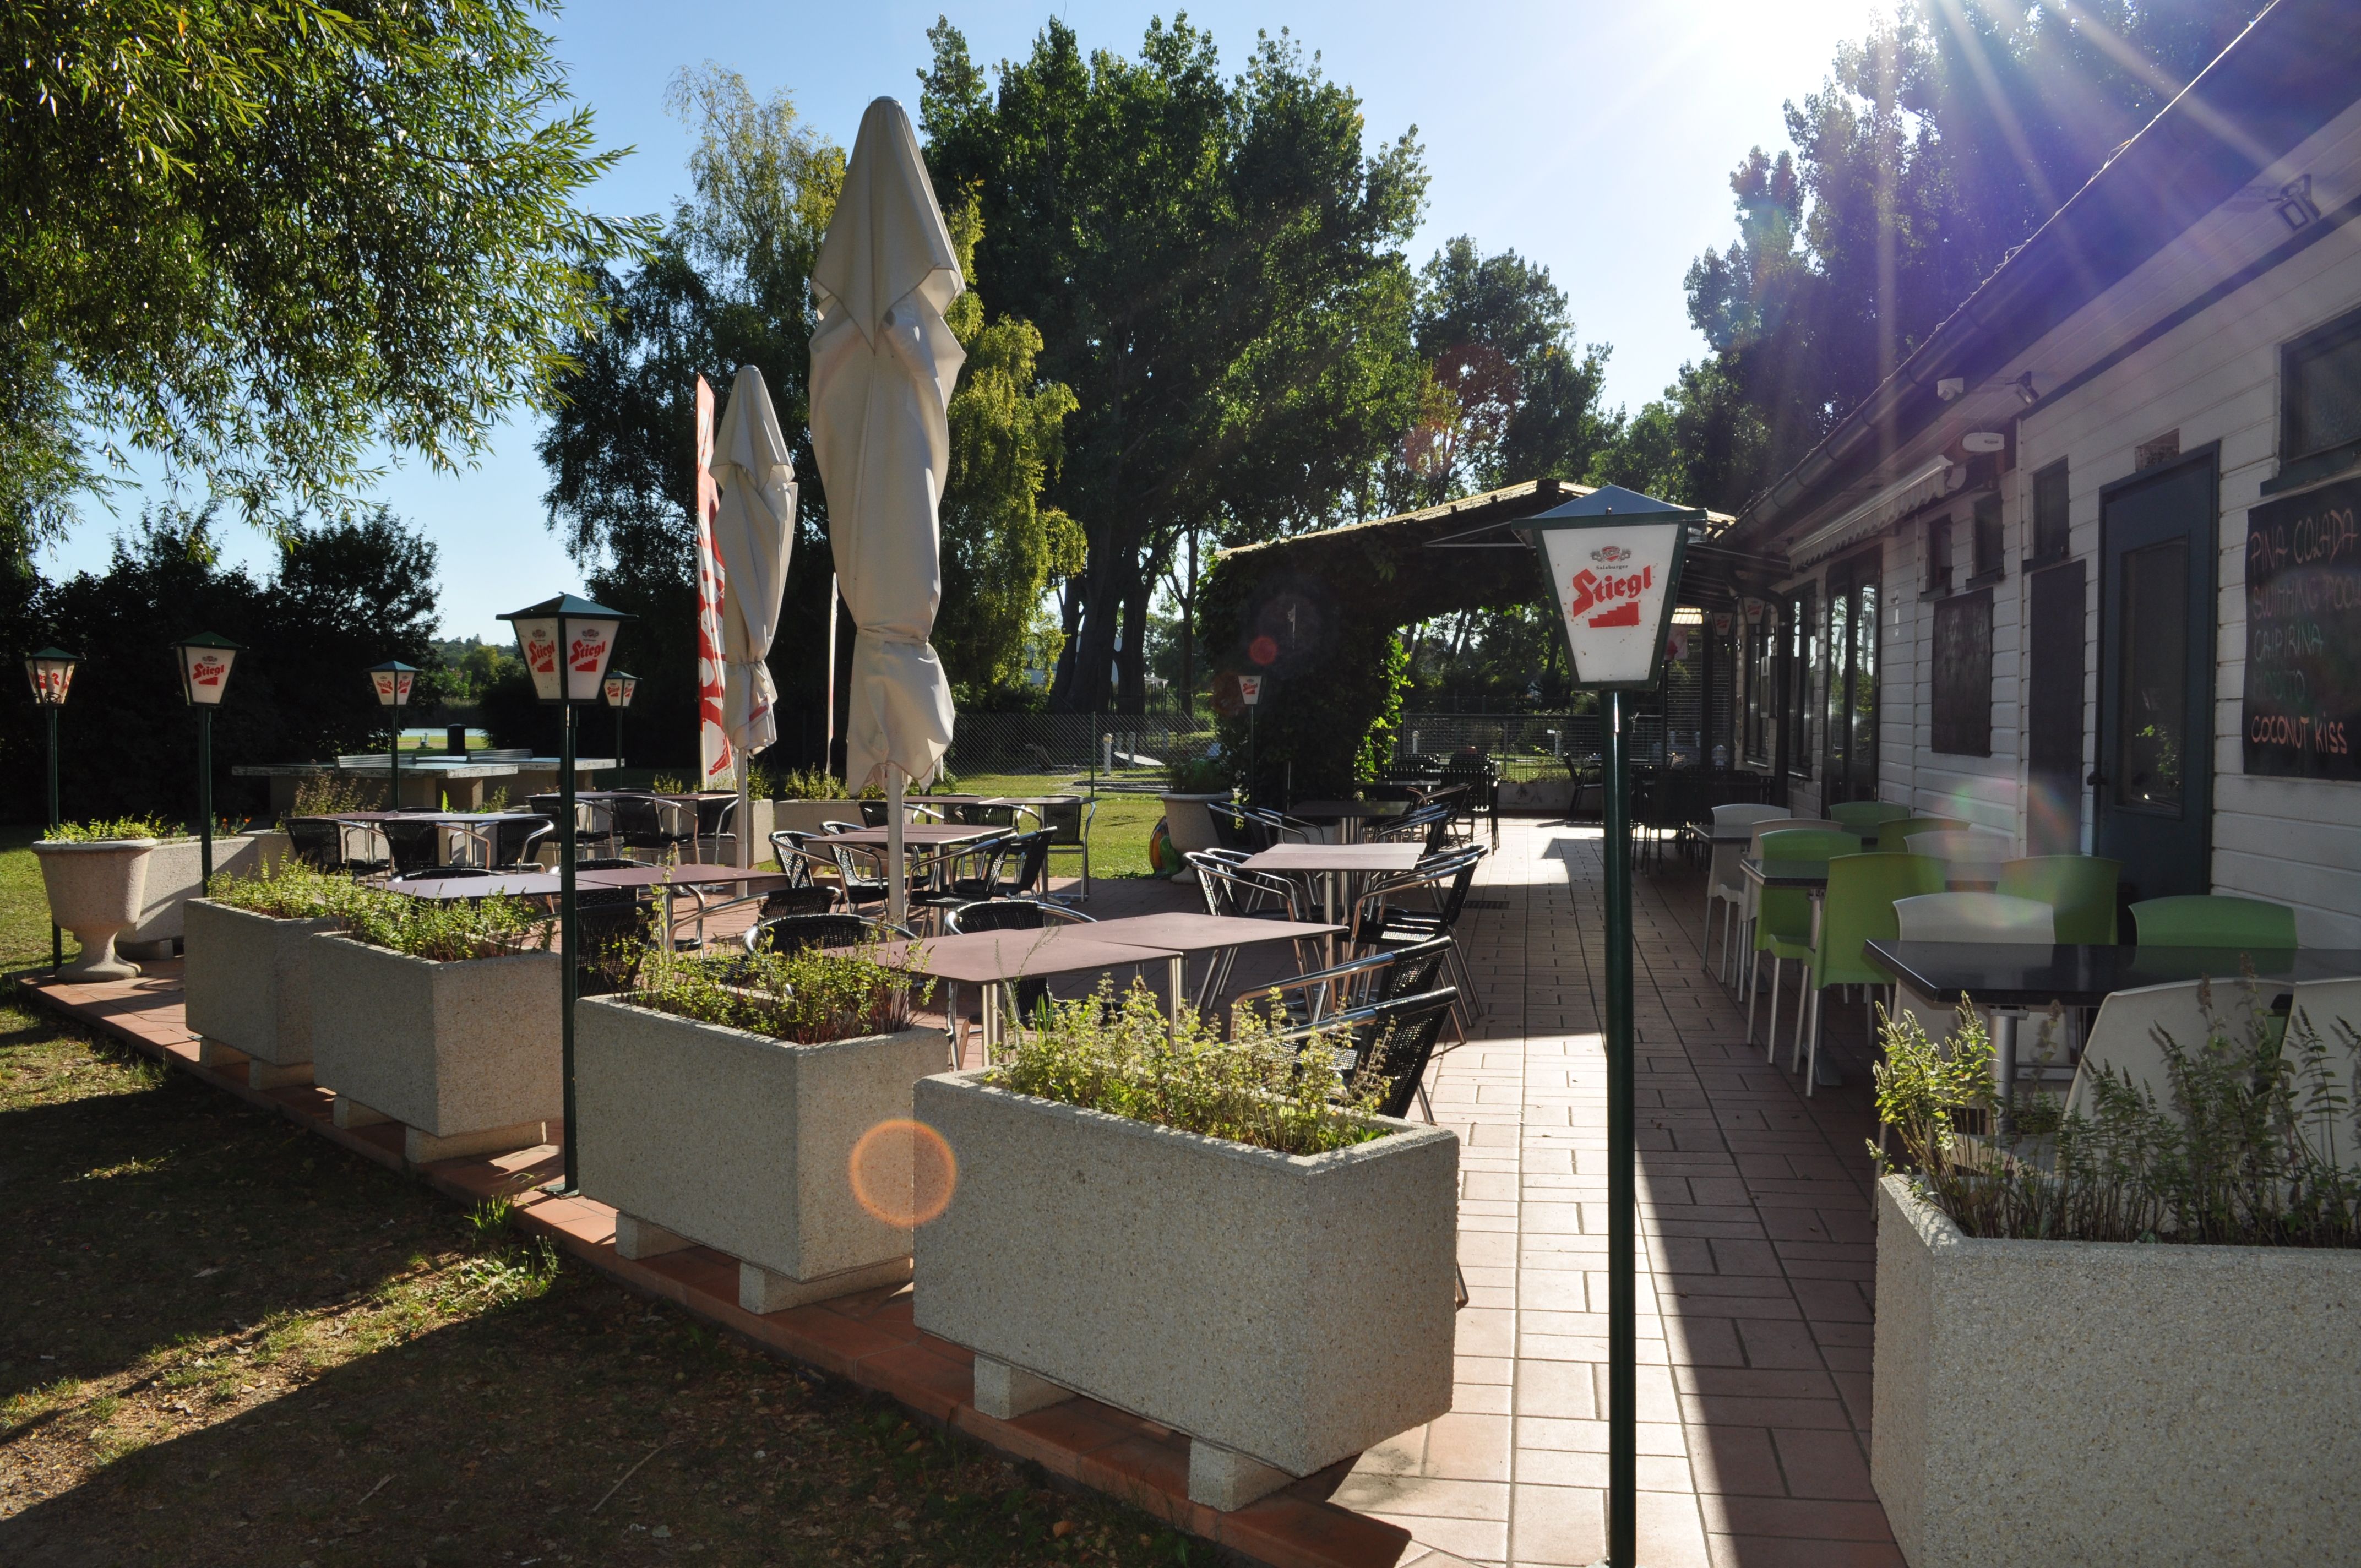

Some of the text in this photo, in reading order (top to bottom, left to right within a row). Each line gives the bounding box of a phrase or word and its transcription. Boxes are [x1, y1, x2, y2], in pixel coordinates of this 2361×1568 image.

[2250, 508, 2359, 576] PINA COLADA
[1573, 565, 1652, 617] Stiegl
[529, 640, 555, 667] Stiegl
[569, 640, 606, 665] Stiegl
[193, 663, 225, 680] Stiegl
[2251, 715, 2310, 751] COCONUT
